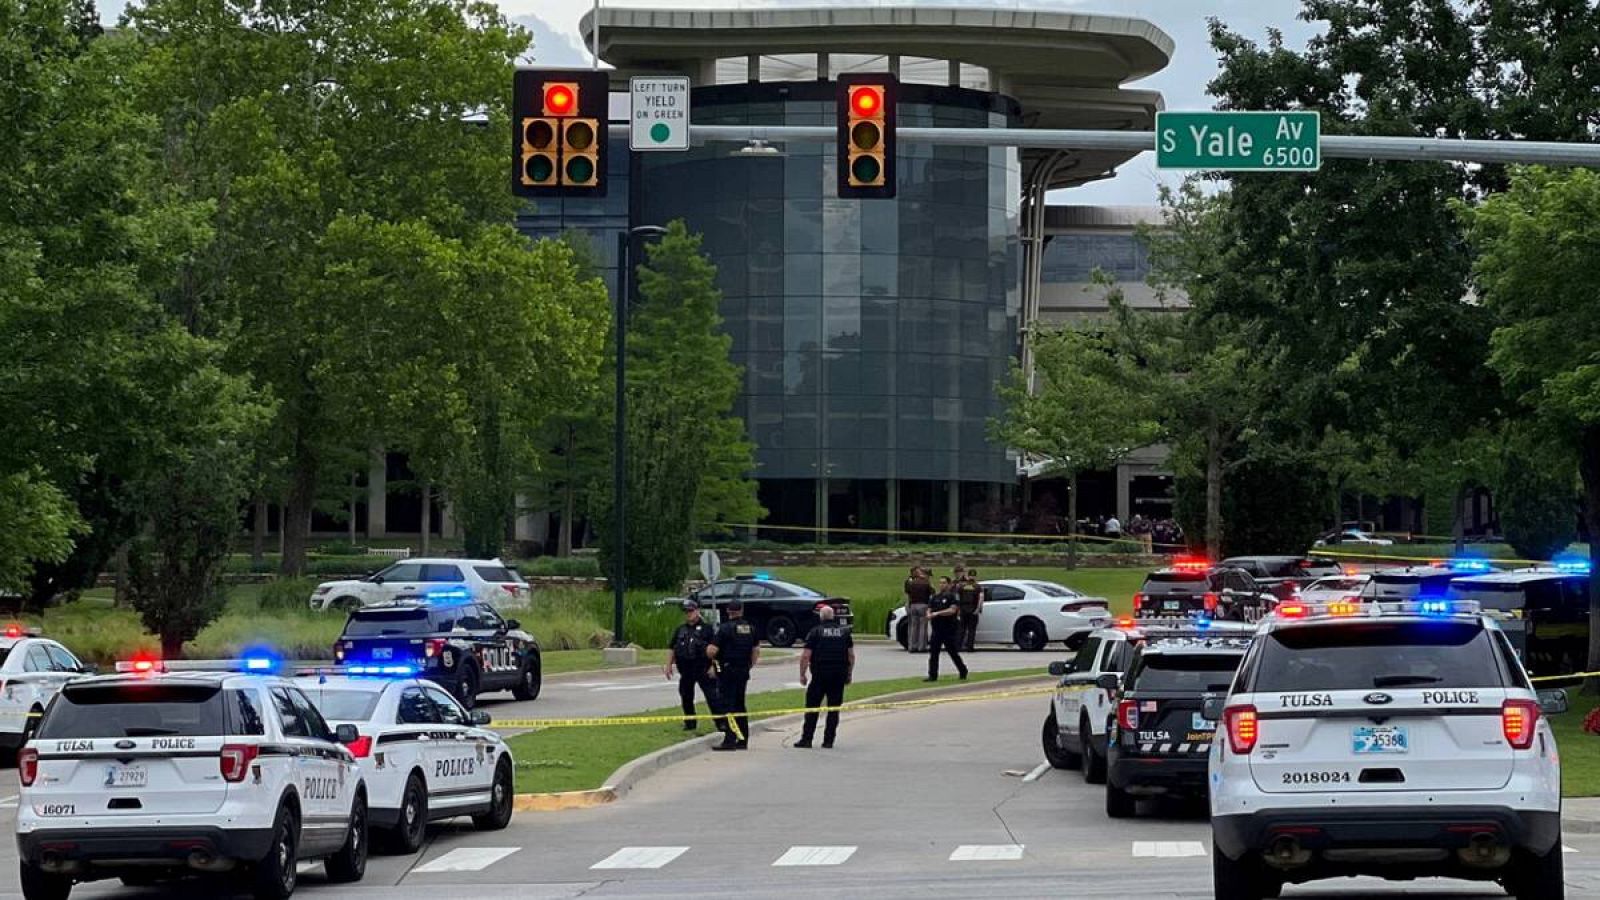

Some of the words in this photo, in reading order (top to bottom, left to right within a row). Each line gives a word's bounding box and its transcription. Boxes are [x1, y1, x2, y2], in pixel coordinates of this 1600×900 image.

[634, 84, 656, 92] LEFT
[662, 84, 685, 92] TURN
[645, 96, 675, 106] YIELD
[636, 111, 649, 119] ON
[654, 110, 683, 119] GREEN
[1275, 116, 1304, 140] Av
[1162, 129, 1176, 153] S
[1189, 125, 1253, 157] Yale
[1263, 147, 1313, 166] 6500
[482, 647, 518, 671] POLICE
[1280, 694, 1334, 707] TULSA
[1423, 691, 1479, 705] POLICE
[1138, 731, 1171, 741] TULSA
[56, 741, 94, 752] TULSA
[152, 738, 195, 750] POLICE
[435, 757, 475, 778] POLICE
[119, 771, 145, 783] 27929
[1282, 772, 1351, 784] 2018024
[304, 778, 337, 799] POLICE
[43, 804, 76, 815] 16071
